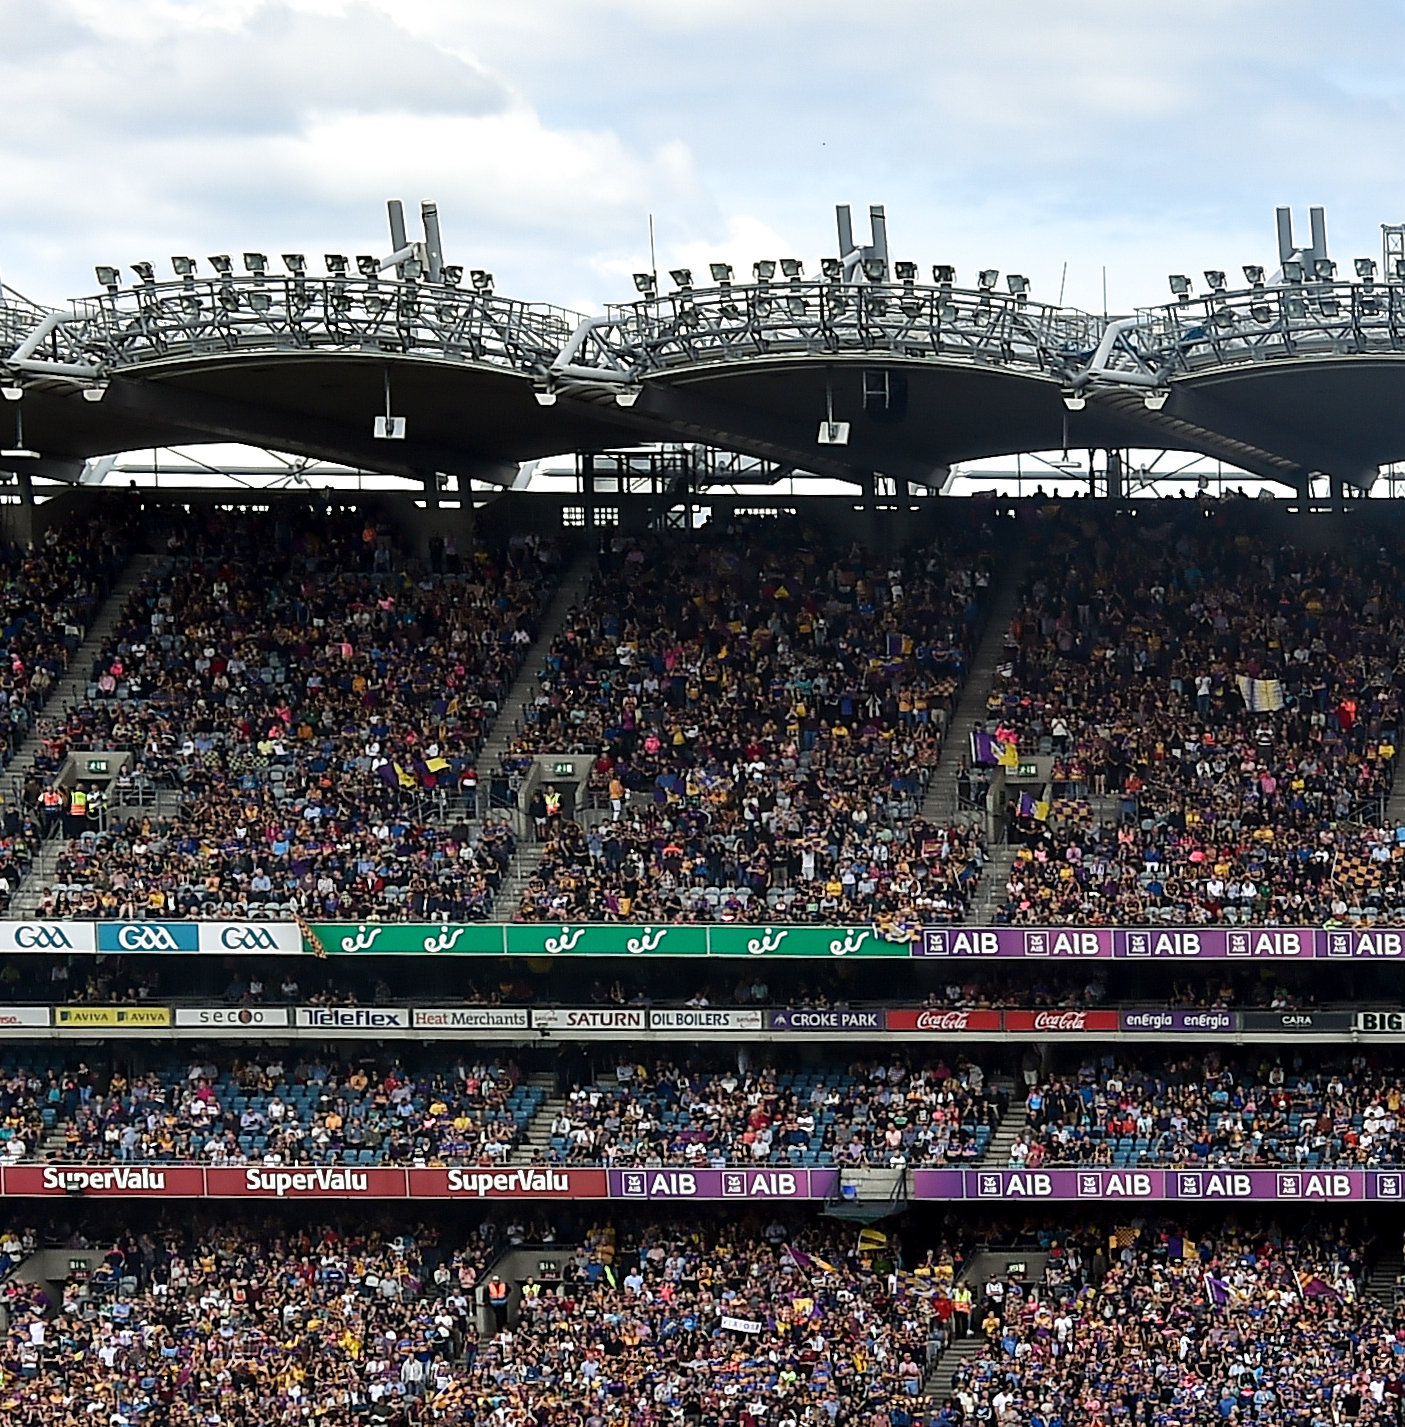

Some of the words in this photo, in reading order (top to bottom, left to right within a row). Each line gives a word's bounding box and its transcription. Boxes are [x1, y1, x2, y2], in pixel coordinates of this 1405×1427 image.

[15, 926, 72, 948] GAA
[119, 926, 178, 949] GAA
[222, 927, 279, 949] GAA
[953, 933, 998, 953] AIB
[1155, 934, 1200, 954] AIB
[1255, 934, 1300, 954] AIB
[306, 1010, 402, 1027] Teleflex
[416, 1013, 448, 1024] Heat
[451, 1012, 525, 1025] Merchants
[567, 1013, 639, 1026] SATURN
[652, 1014, 673, 1025] OIL
[676, 1011, 730, 1026] BOILERS
[791, 1014, 837, 1026] CROKE
[842, 1014, 876, 1026] PARK
[1364, 1014, 1401, 1030] BIG
[246, 1169, 367, 1195] SuperValu
[448, 1170, 570, 1196] SuperValu
[651, 1174, 696, 1194] AIB
[751, 1174, 795, 1194] AIB
[1106, 1175, 1150, 1195] AIB
[1306, 1176, 1350, 1196] AIB
